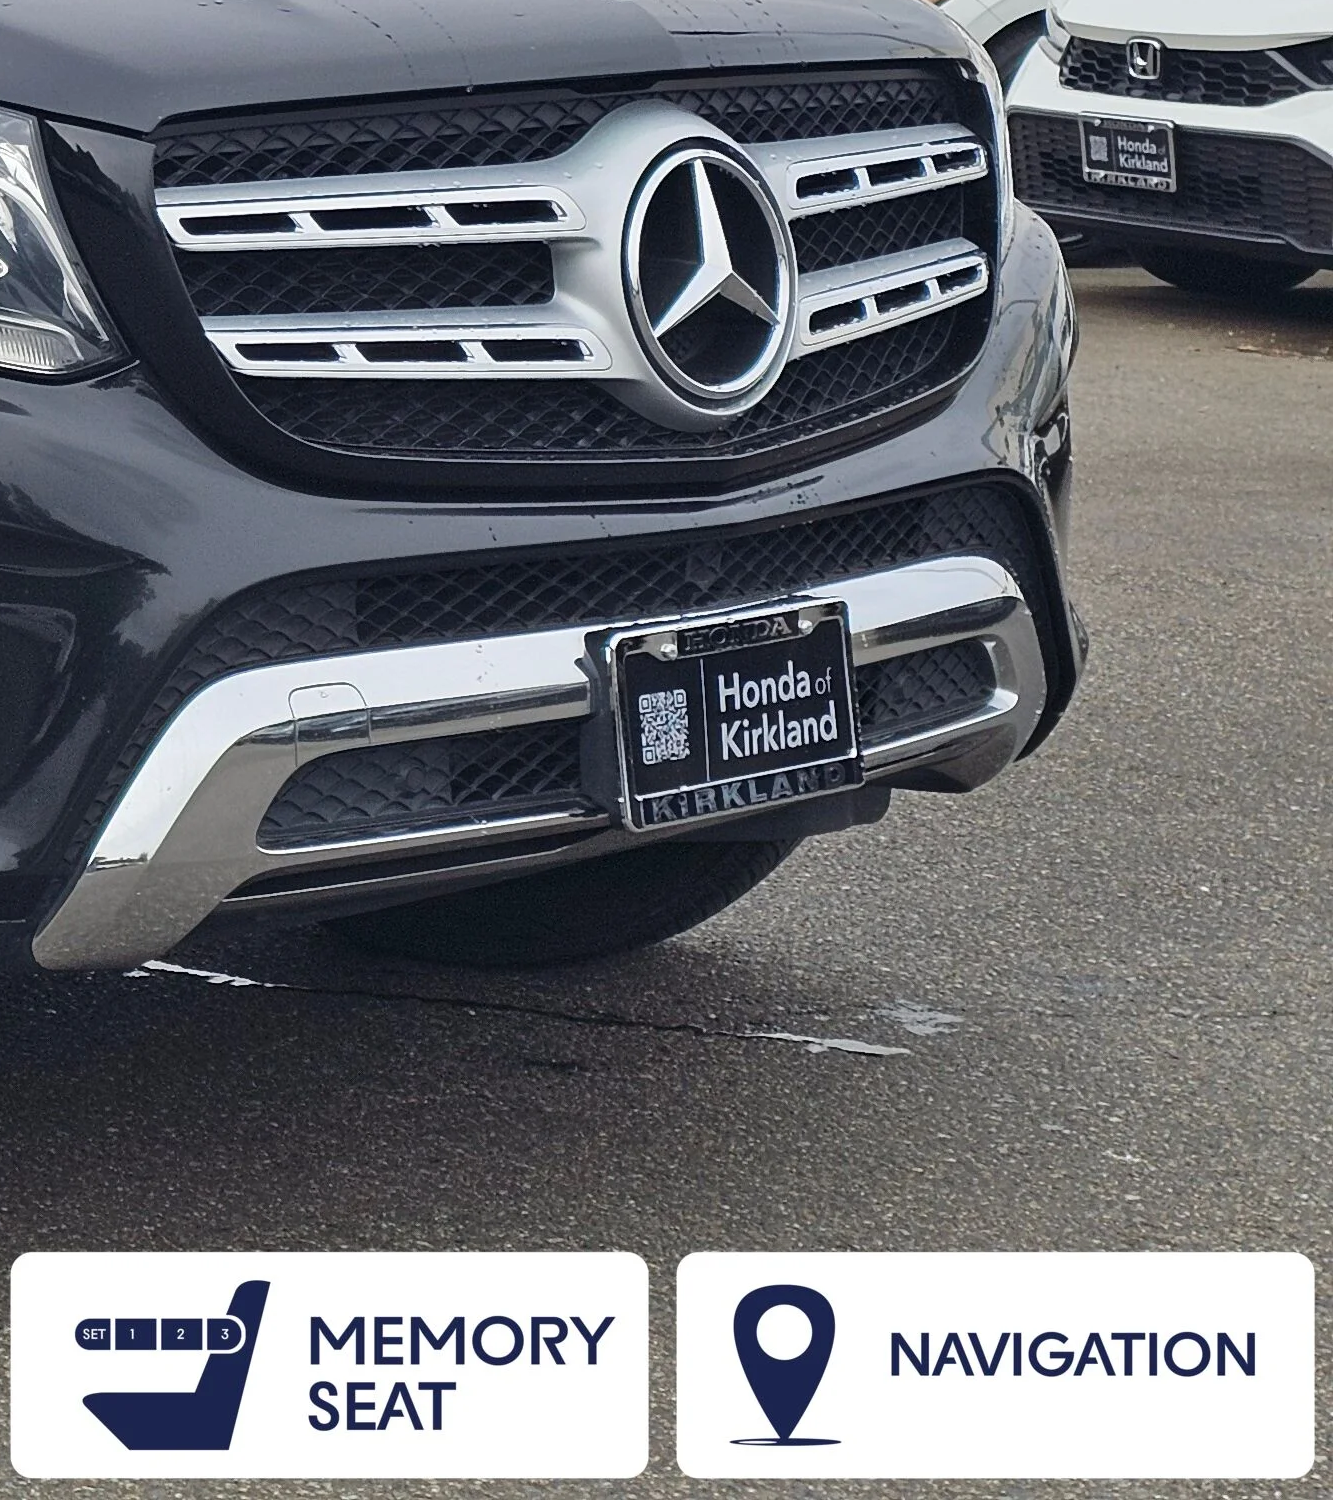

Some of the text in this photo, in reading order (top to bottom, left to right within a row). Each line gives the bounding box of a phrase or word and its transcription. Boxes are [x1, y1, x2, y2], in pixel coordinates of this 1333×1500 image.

[1117, 135, 1157, 155] Honda
[1118, 153, 1169, 173] Kirkland
[684, 617, 791, 650] HONDA
[718, 659, 832, 713] Honda of
[720, 700, 838, 761] Kirkland
[651, 762, 846, 823] KIRKLAND
